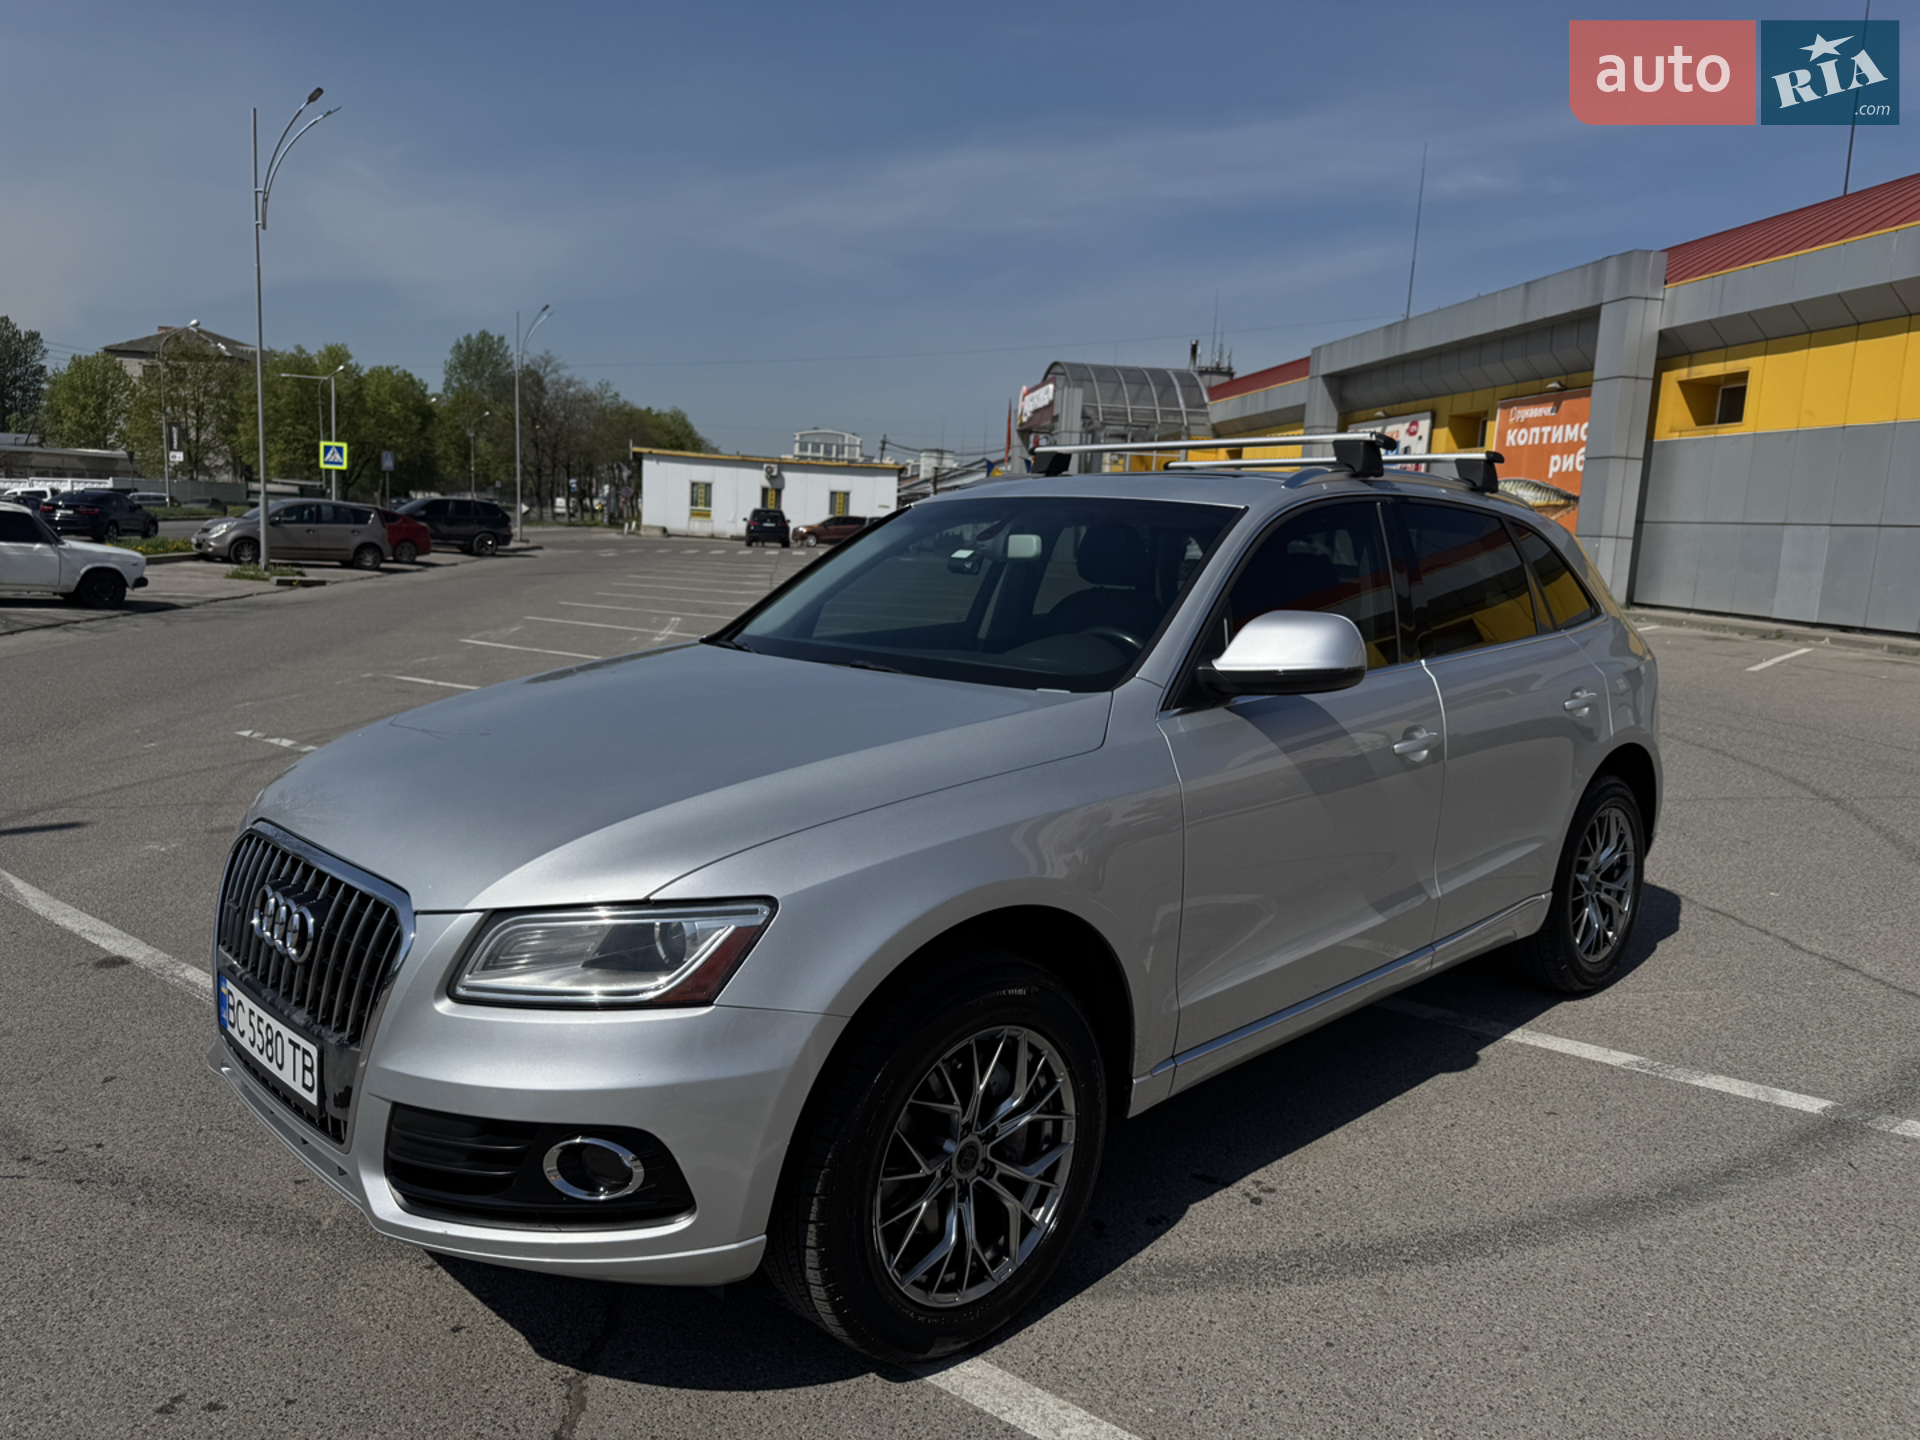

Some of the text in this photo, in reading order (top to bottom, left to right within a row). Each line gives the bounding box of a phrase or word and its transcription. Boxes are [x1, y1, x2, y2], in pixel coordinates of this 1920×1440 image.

[228, 989, 315, 1094] BC 5580 TB
